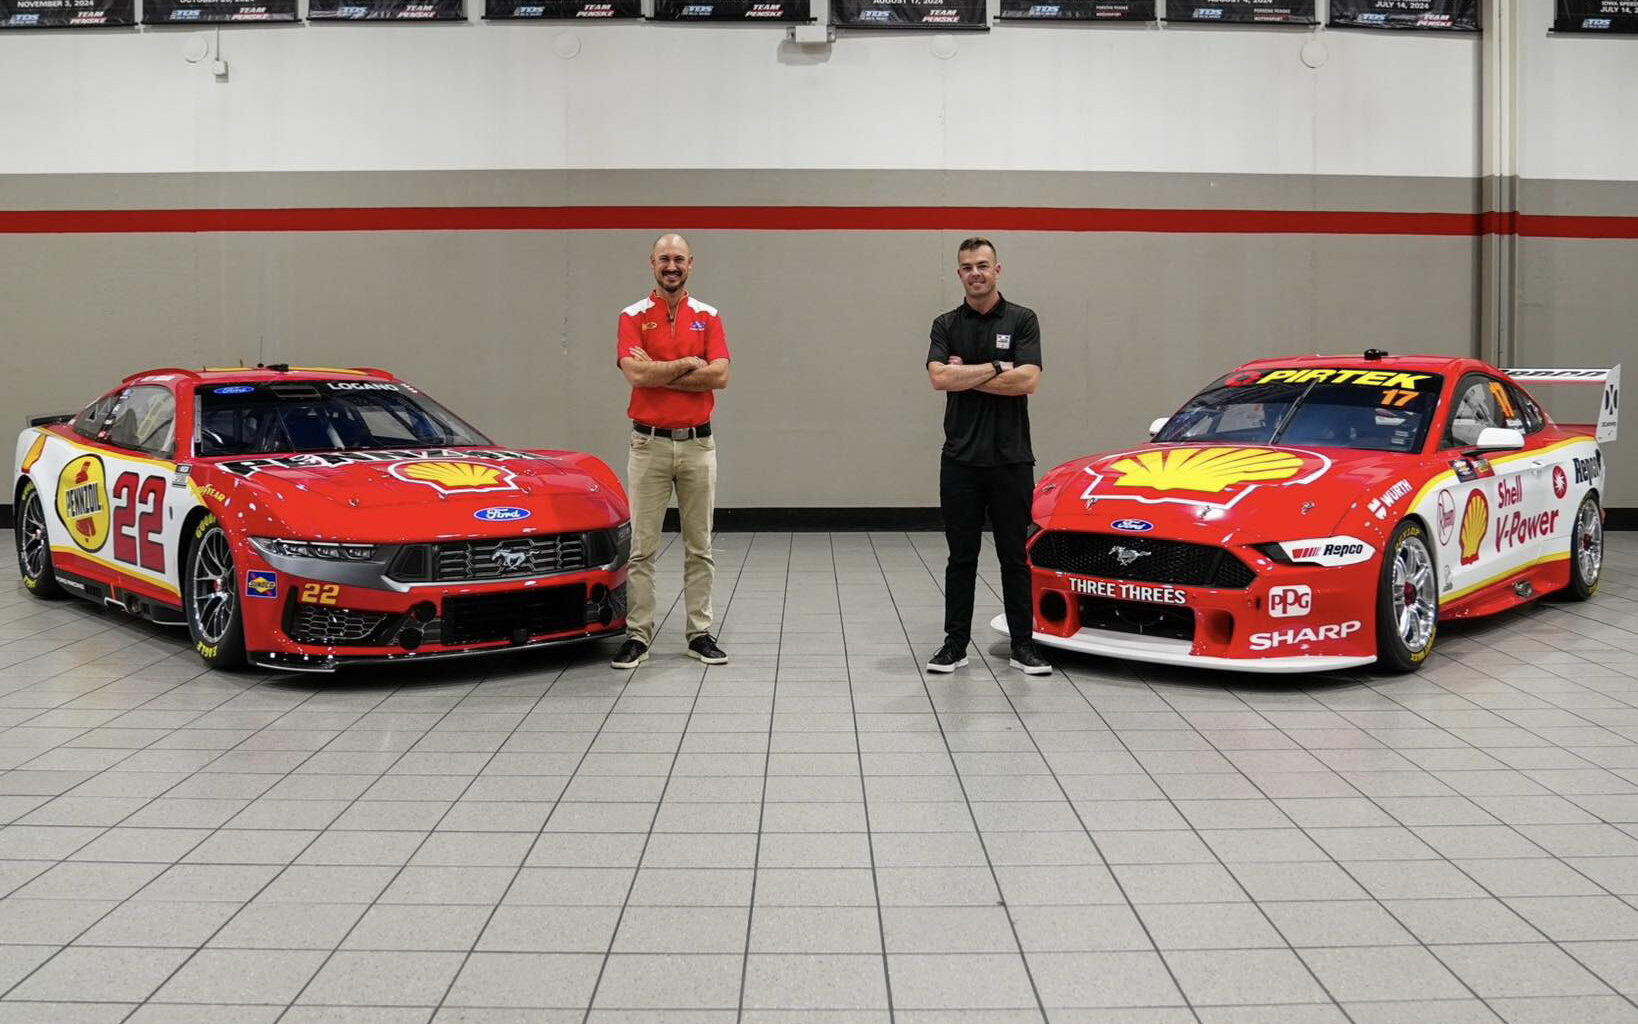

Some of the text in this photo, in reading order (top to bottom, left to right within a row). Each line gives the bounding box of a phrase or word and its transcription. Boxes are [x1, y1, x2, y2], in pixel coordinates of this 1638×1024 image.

[328, 382, 399, 391] LOGANO
[1256, 369, 1432, 389] PIRTEK
[1380, 389, 1420, 407] 17
[65, 482, 103, 518] PENNZOIL
[1498, 475, 1522, 509] Shell
[113, 471, 166, 574] 22
[1495, 509, 1559, 552] V-Power
[1323, 544, 1364, 558] Repco
[302, 583, 340, 605] 22
[1069, 577, 1186, 604] THREE THREES
[1271, 588, 1310, 614] PPG
[1248, 620, 1362, 651] SHARP
